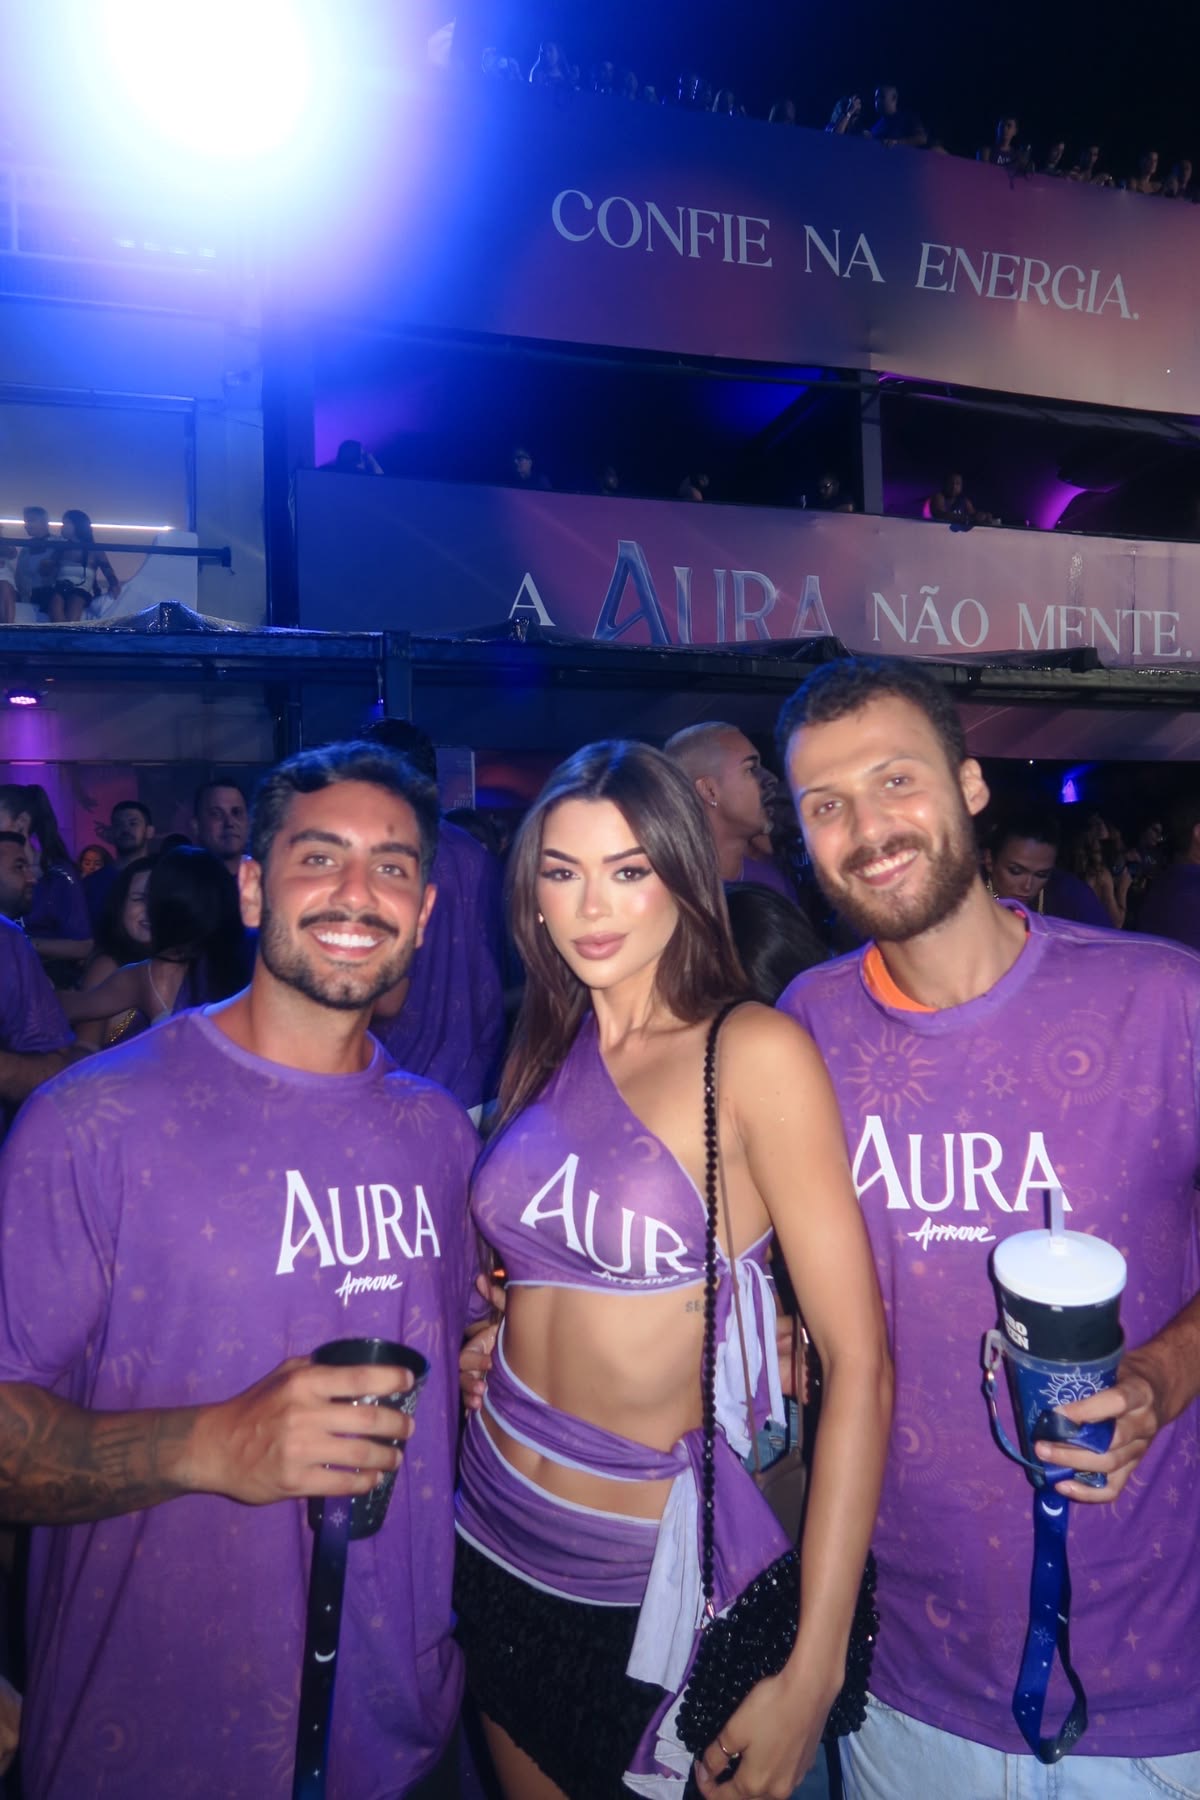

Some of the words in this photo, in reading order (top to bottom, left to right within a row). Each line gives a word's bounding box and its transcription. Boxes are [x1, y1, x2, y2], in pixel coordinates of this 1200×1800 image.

[551, 188, 773, 268] CONFIE
[803, 224, 885, 284] NA
[914, 241, 1140, 320] ENERGIA.
[507, 571, 556, 628] A
[592, 538, 834, 645] AURA
[870, 585, 990, 648] NÃO
[1017, 602, 1193, 659] MENTE.
[275, 1168, 442, 1276] AURA
[519, 1152, 719, 1277] AUR
[852, 1115, 1074, 1213] AURA
